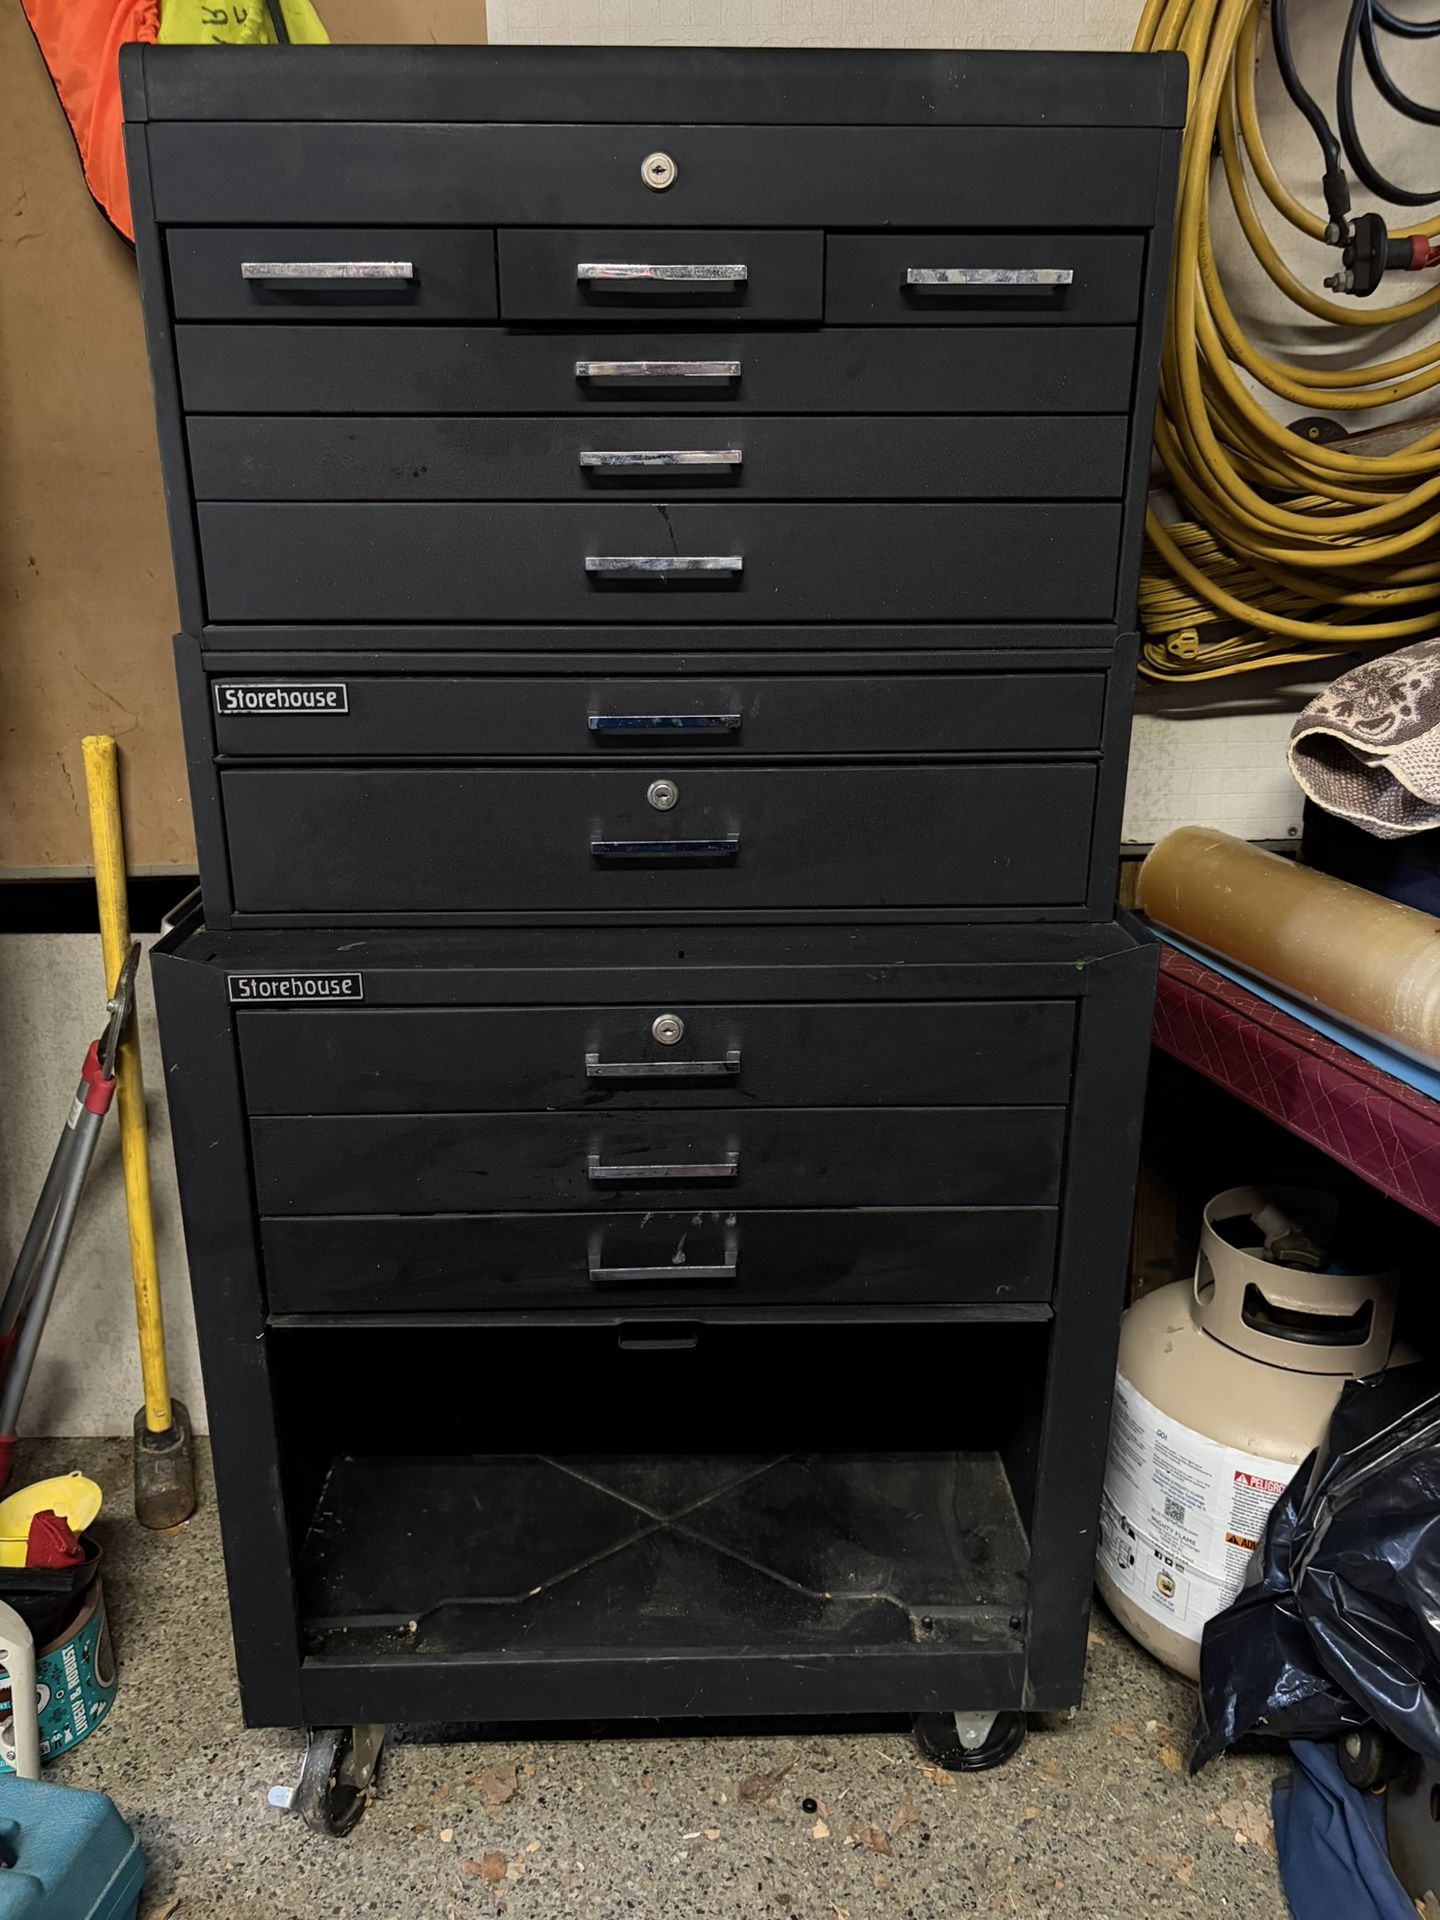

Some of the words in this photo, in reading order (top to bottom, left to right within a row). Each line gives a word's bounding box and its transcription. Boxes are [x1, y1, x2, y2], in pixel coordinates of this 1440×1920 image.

[225, 688, 337, 708] Storehouse
[238, 978, 352, 997] Storehouse
[61, 1644, 81, 1690] ROBUST
[69, 1687, 82, 1702] &
[71, 1698, 89, 1737] LIVELY
